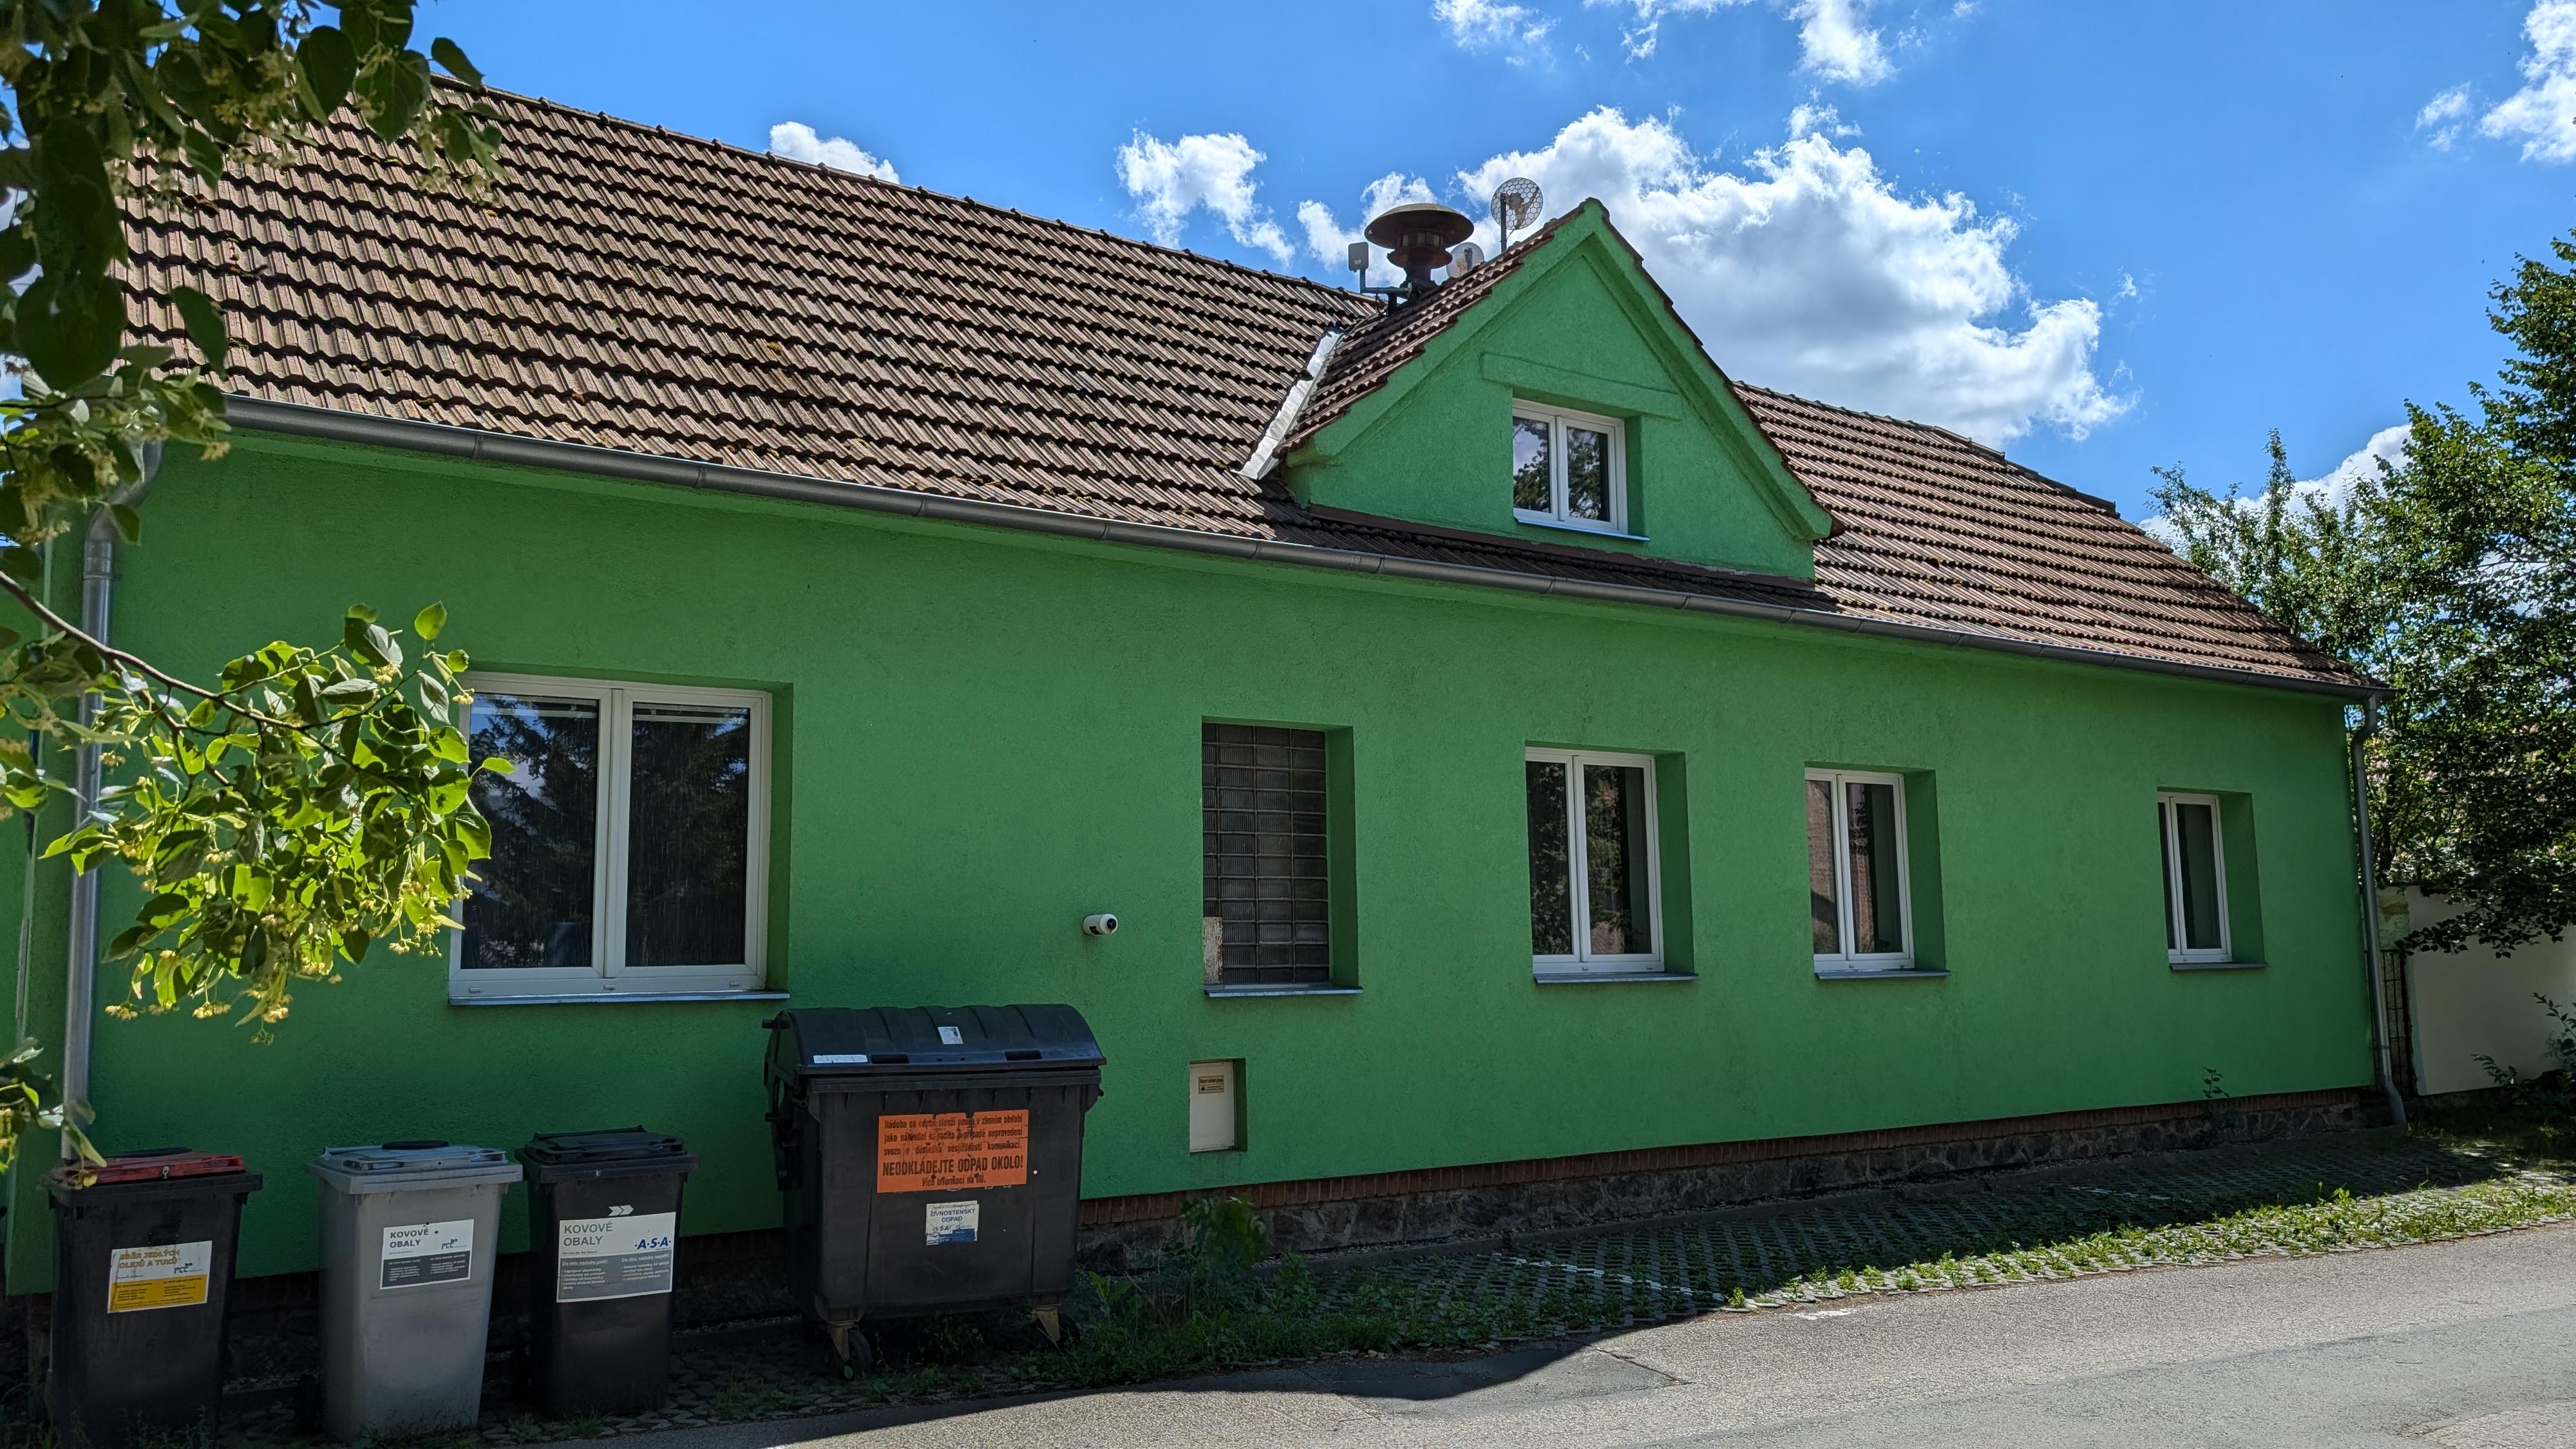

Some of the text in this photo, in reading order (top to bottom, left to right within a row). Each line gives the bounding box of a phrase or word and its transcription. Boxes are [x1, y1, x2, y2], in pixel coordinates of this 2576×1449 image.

[885, 1119, 907, 1129] Nádoba
[981, 1115, 1002, 1124] zimním
[1004, 1113, 1023, 1123] období
[884, 1133, 898, 1144] jako
[988, 1127, 1023, 1139] neprovedení
[884, 1148, 901, 1156] svozu
[882, 1155, 1023, 1176] NEODKLÁDEJTE ODPAD OKOLO!
[922, 1177, 935, 1186] Více
[937, 1175, 965, 1186] informací
[390, 1227, 429, 1238] KOVOVÉ
[564, 1221, 613, 1234] KOVOVÉ
[390, 1239, 421, 1248] OBALY
[564, 1236, 603, 1246] OBALY
[144, 1249, 180, 1259] JEDLÝCH
[119, 1258, 145, 1269] OLEJŮ
[155, 1257, 176, 1265] TUKŮ
